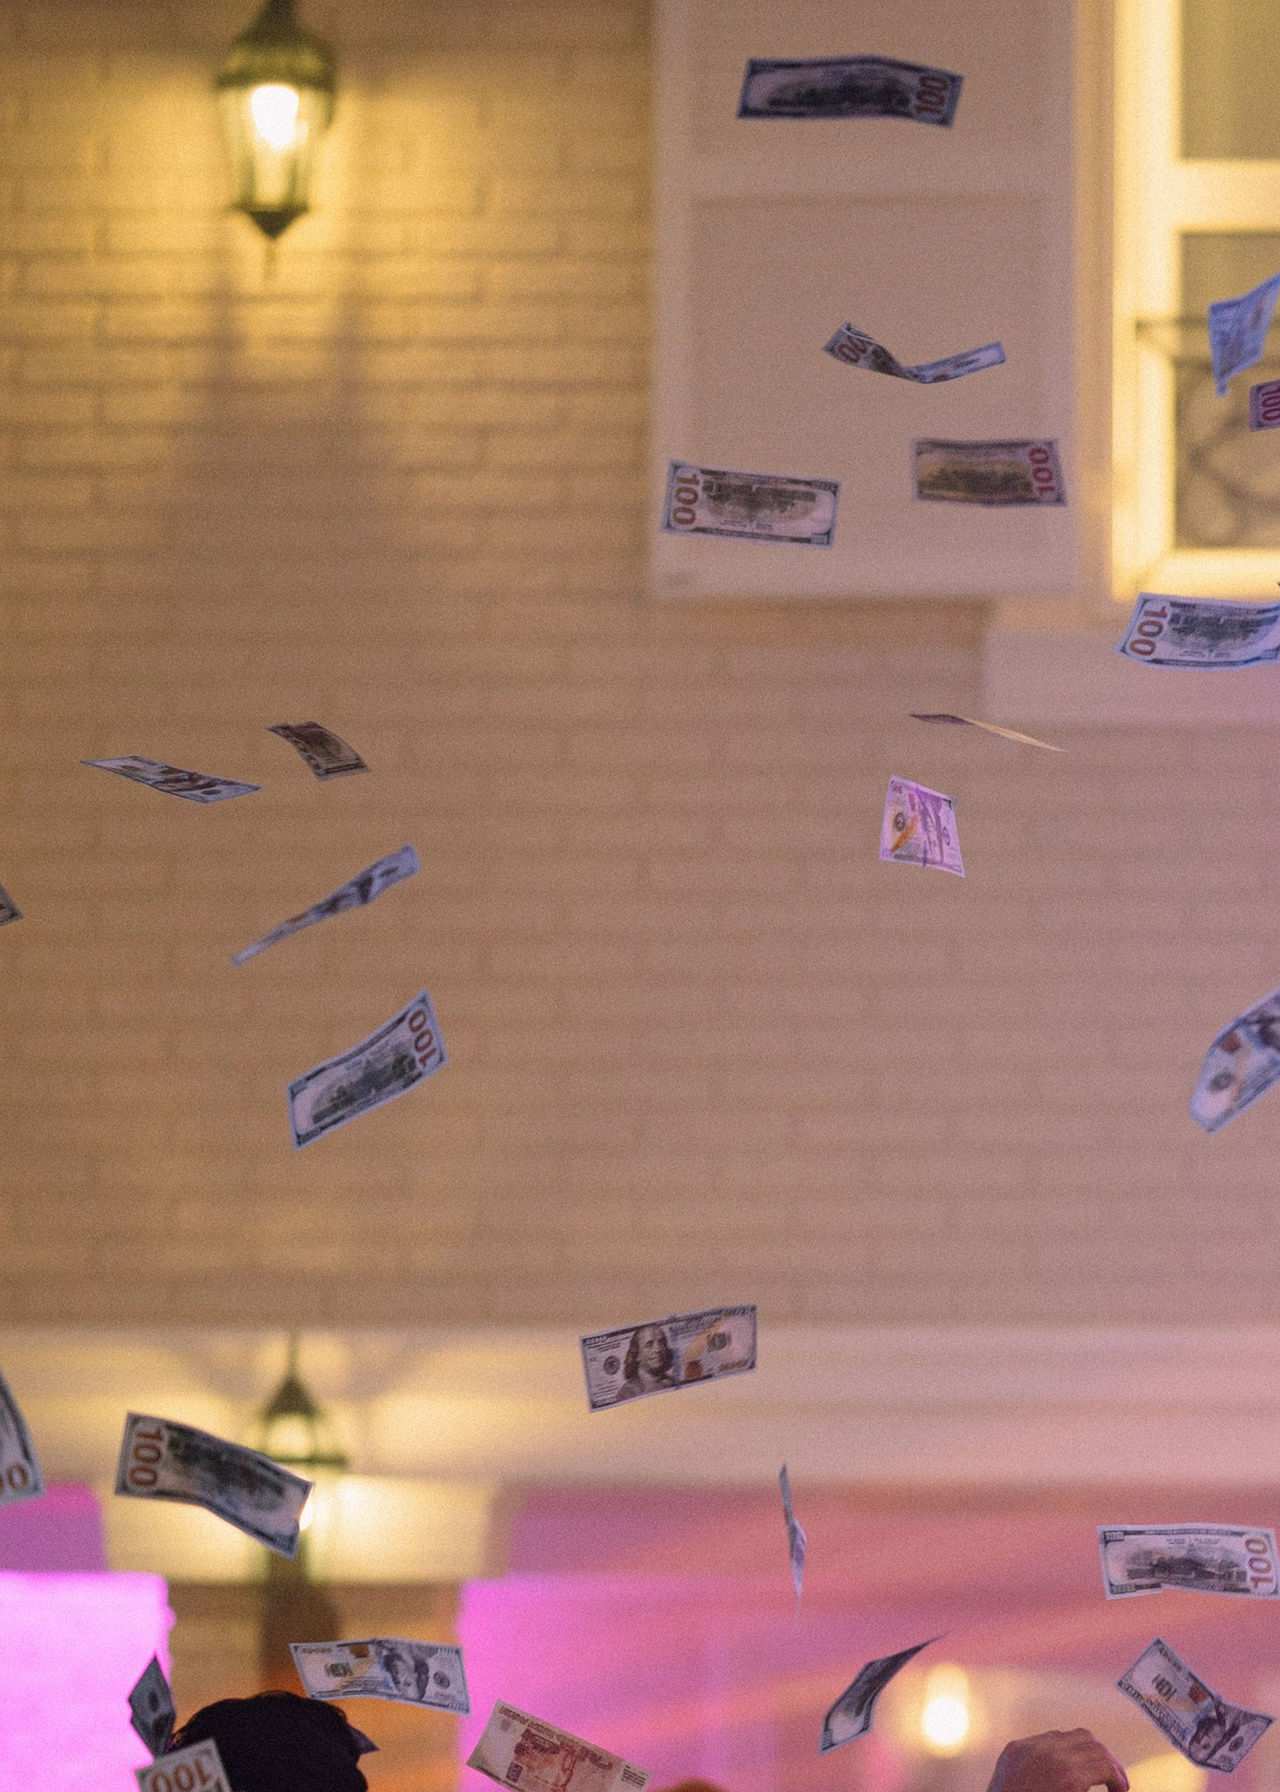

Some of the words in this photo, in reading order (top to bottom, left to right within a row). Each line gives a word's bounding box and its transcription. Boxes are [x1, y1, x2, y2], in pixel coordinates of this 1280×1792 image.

[912, 75, 949, 115] 100
[1027, 446, 1058, 497] 100
[672, 473, 701, 526] 100
[1129, 605, 1169, 657] 100
[407, 1007, 436, 1068] 100
[129, 1428, 164, 1488] 100
[1245, 1538, 1274, 1589] 100
